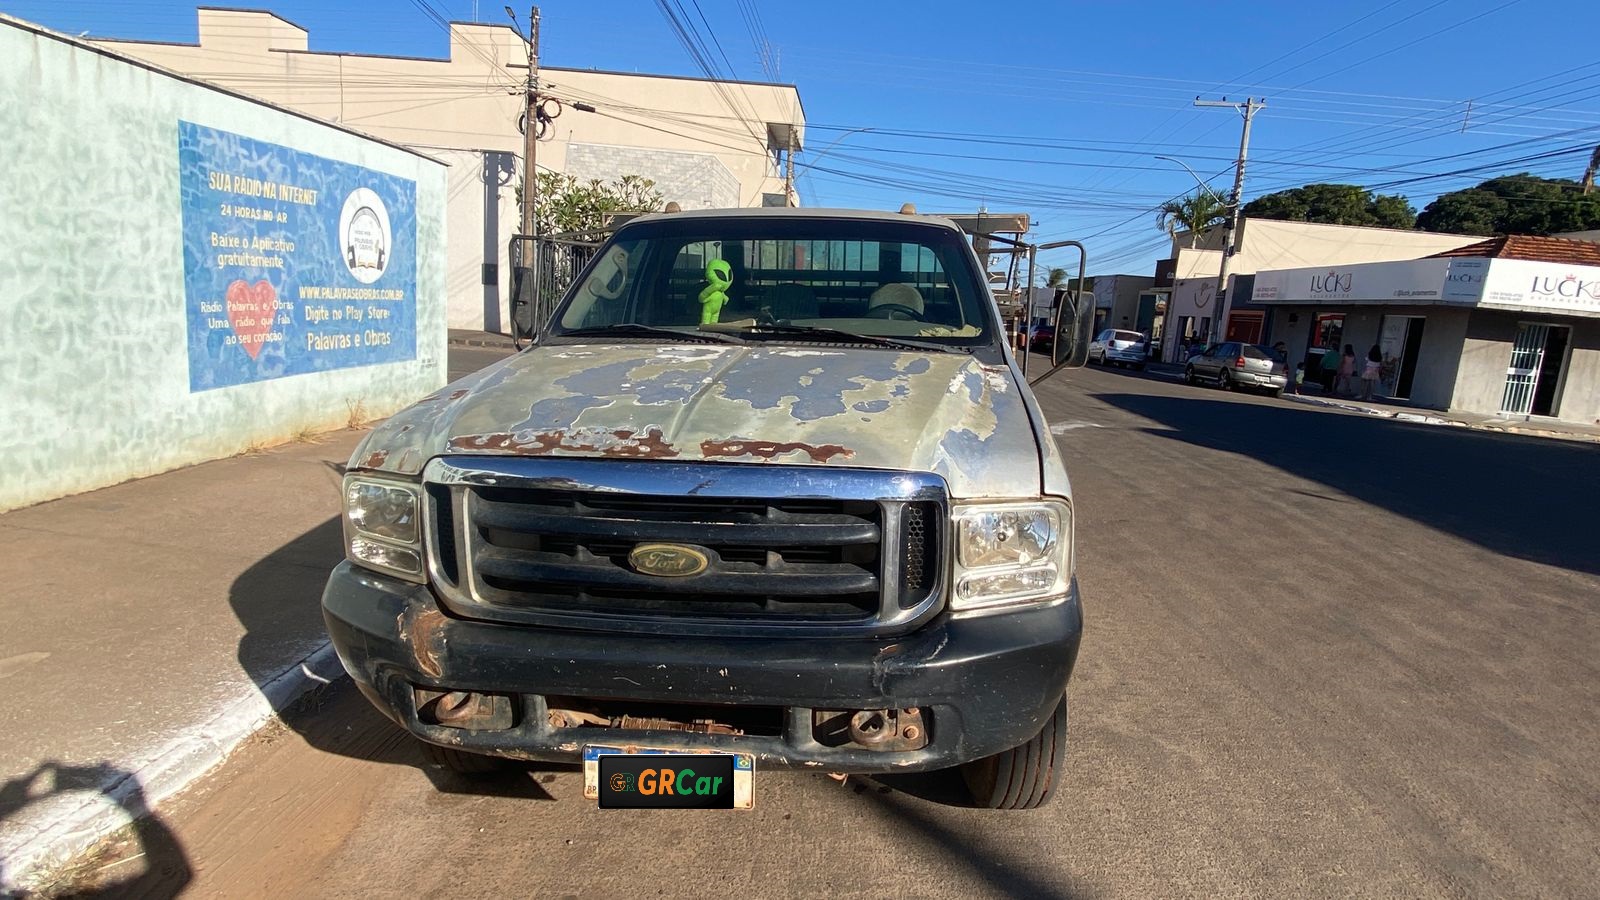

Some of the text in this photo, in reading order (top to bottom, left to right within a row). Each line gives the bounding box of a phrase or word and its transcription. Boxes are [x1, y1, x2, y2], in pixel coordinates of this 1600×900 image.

[209, 171, 318, 206] SUA RÁDIO NA INTERNET
[221, 204, 288, 224] 24 HORAS NO AR
[211, 231, 295, 253] Baixe o Aplicativo
[217, 252, 284, 269] gratuitamente
[201, 301, 222, 313] Rádio
[227, 300, 259, 312] Palavras
[272, 299, 294, 310] Obras
[305, 305, 329, 325] Digite
[332, 309, 342, 320] no
[346, 305, 363, 322] Play
[208, 318, 229, 328] Uma
[226, 335, 236, 345] ao
[239, 333, 251, 344] seu
[308, 329, 391, 351] Palavras e Obras
[645, 551, 687, 569] Ford
